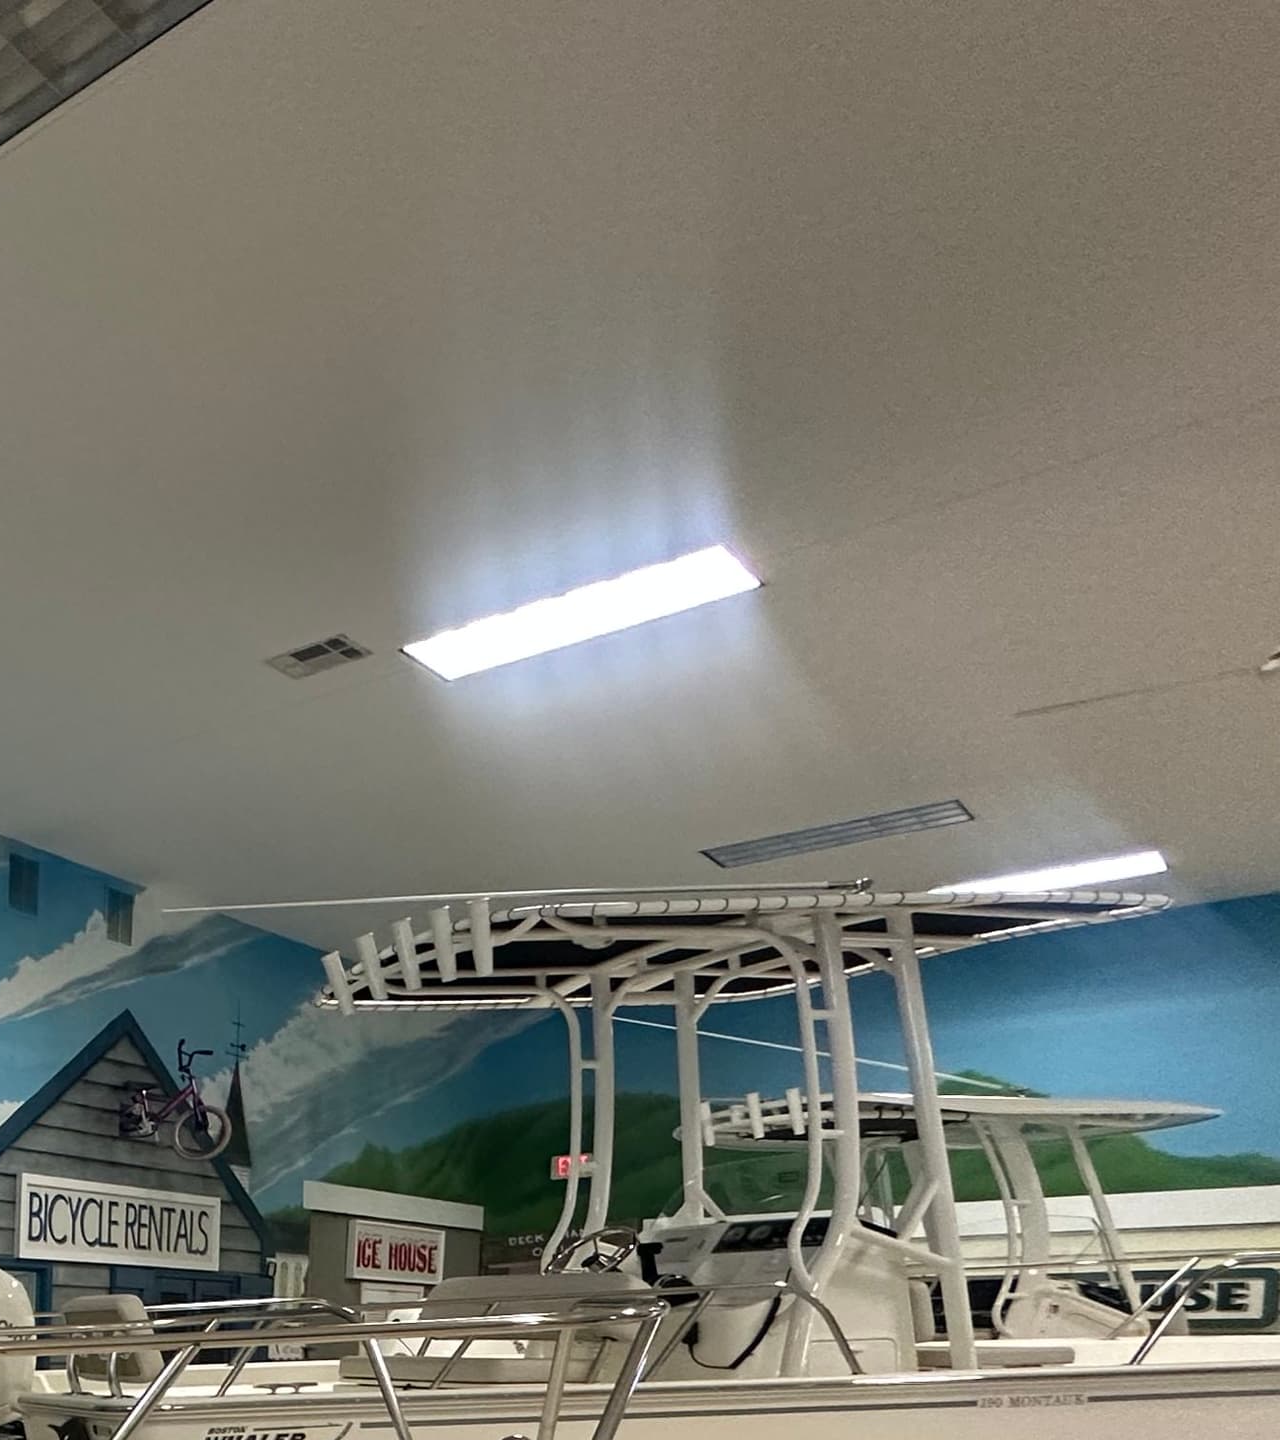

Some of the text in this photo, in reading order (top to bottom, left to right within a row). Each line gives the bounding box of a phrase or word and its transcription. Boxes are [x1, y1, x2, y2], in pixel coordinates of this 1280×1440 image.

[28, 1191, 210, 1256] BICYCLE RENTALS
[356, 1238, 438, 1274] ICE HOUSE
